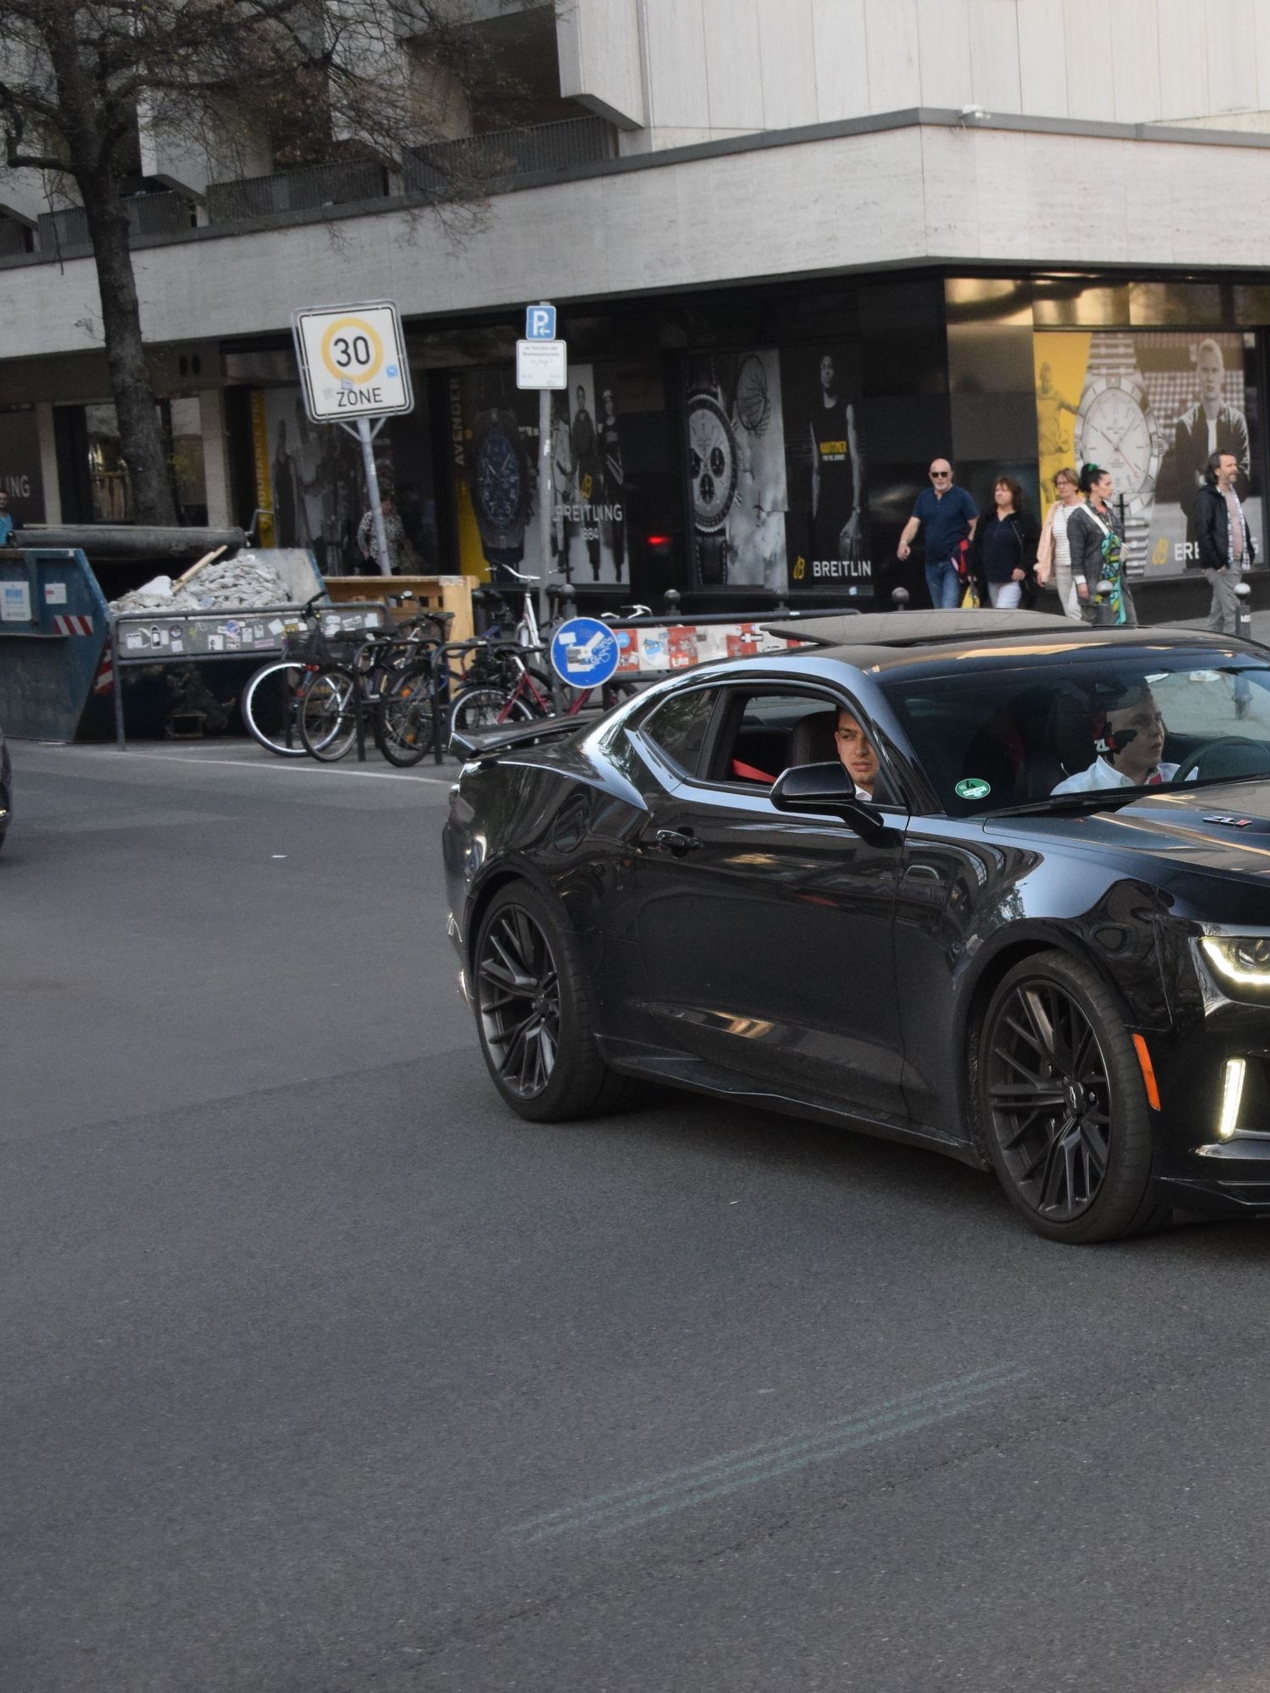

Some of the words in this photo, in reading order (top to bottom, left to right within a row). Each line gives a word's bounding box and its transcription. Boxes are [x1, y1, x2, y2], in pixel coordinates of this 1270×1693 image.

[333, 335, 371, 367] 30
[336, 387, 384, 408] ZONE
[813, 560, 872, 577] BREITLIN
